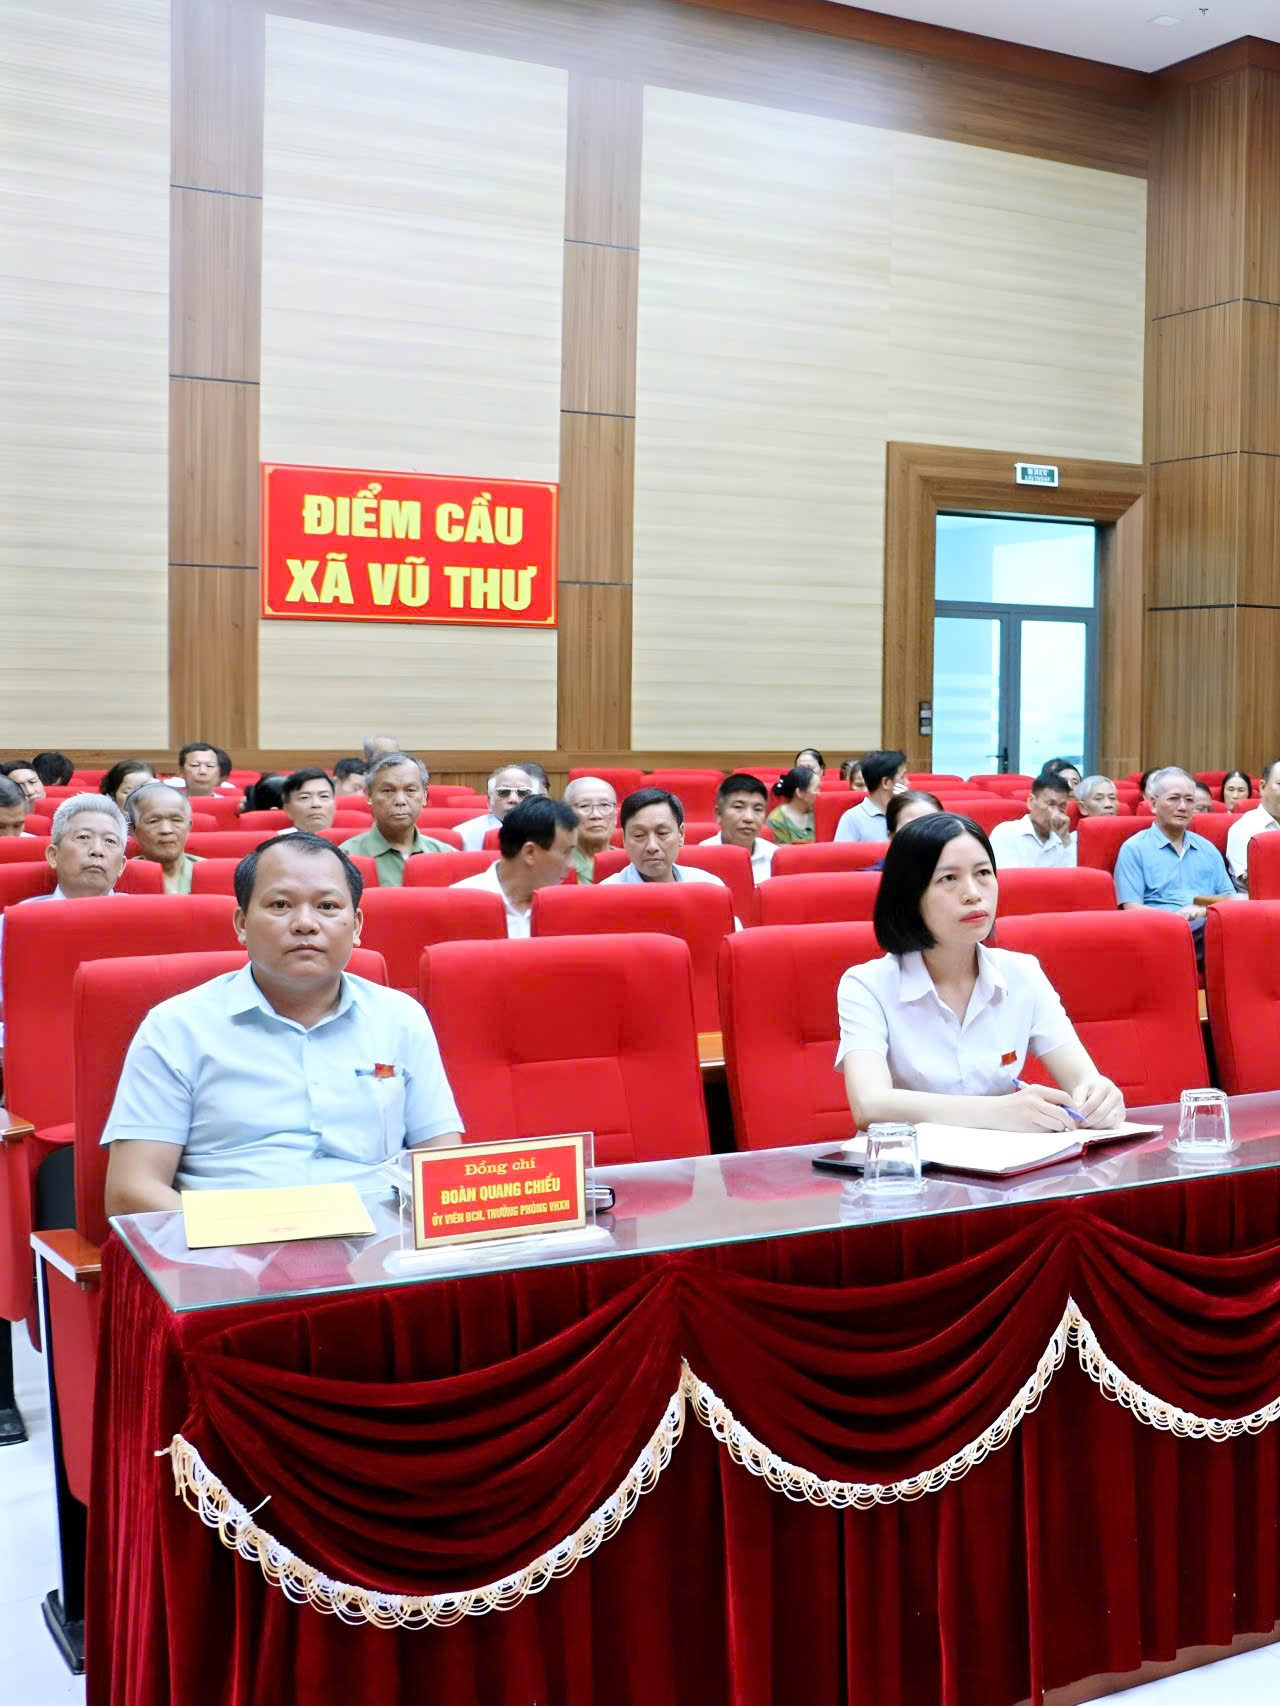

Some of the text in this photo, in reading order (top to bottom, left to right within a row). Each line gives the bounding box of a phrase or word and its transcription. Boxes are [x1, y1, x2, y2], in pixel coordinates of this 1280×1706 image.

[301, 482, 524, 546] ĐIỂM CẦU
[285, 552, 538, 611] XÃ VŨ THƯ
[440, 1172, 561, 1205] ĐOÀN QUANG CHIẾU
[464, 1157, 536, 1176] Đồng chí
